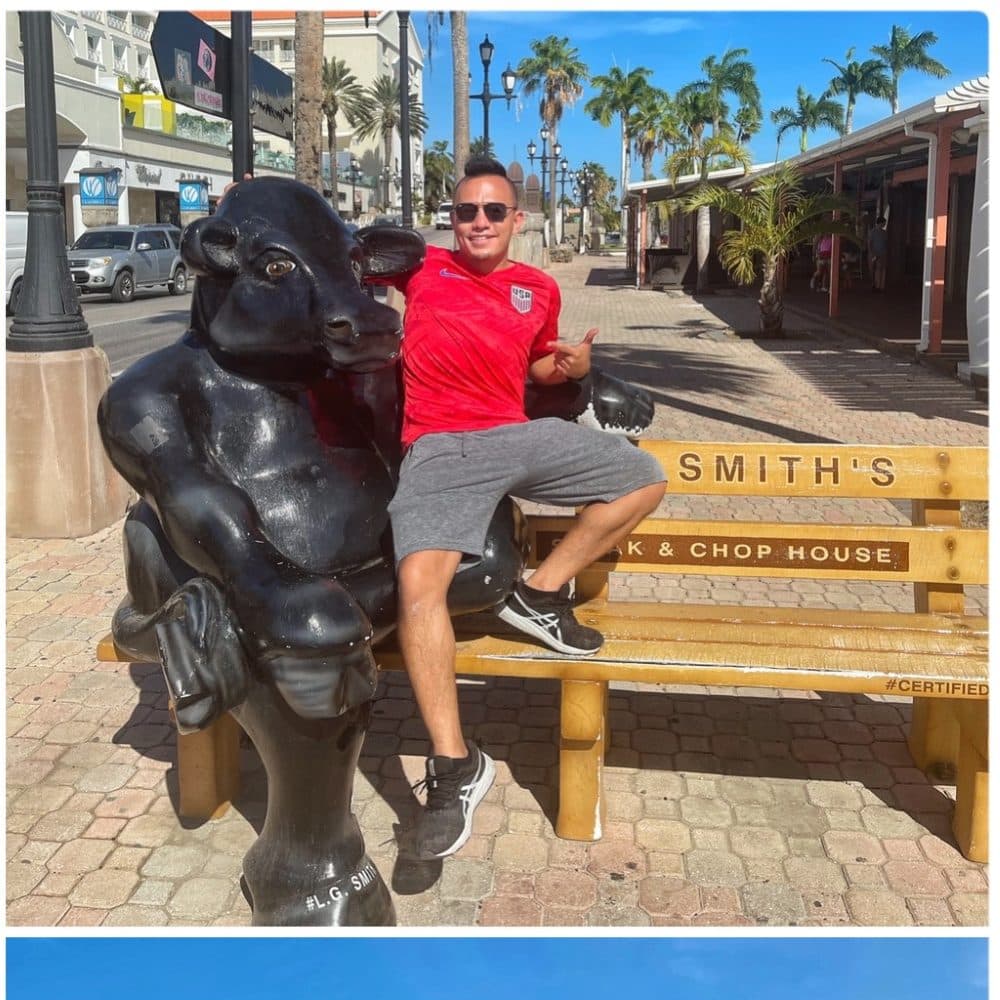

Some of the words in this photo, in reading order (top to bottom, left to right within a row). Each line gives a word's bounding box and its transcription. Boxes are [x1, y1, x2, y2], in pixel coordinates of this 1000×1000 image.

[512, 287, 531, 299] USA
[679, 452, 896, 487] SMITH'S
[658, 541, 674, 557] &
[690, 541, 773, 560] CHOP
[788, 545, 893, 564] HOUSE
[885, 678, 989, 696] #CERTIFIED
[305, 886, 349, 911] #L.G.
